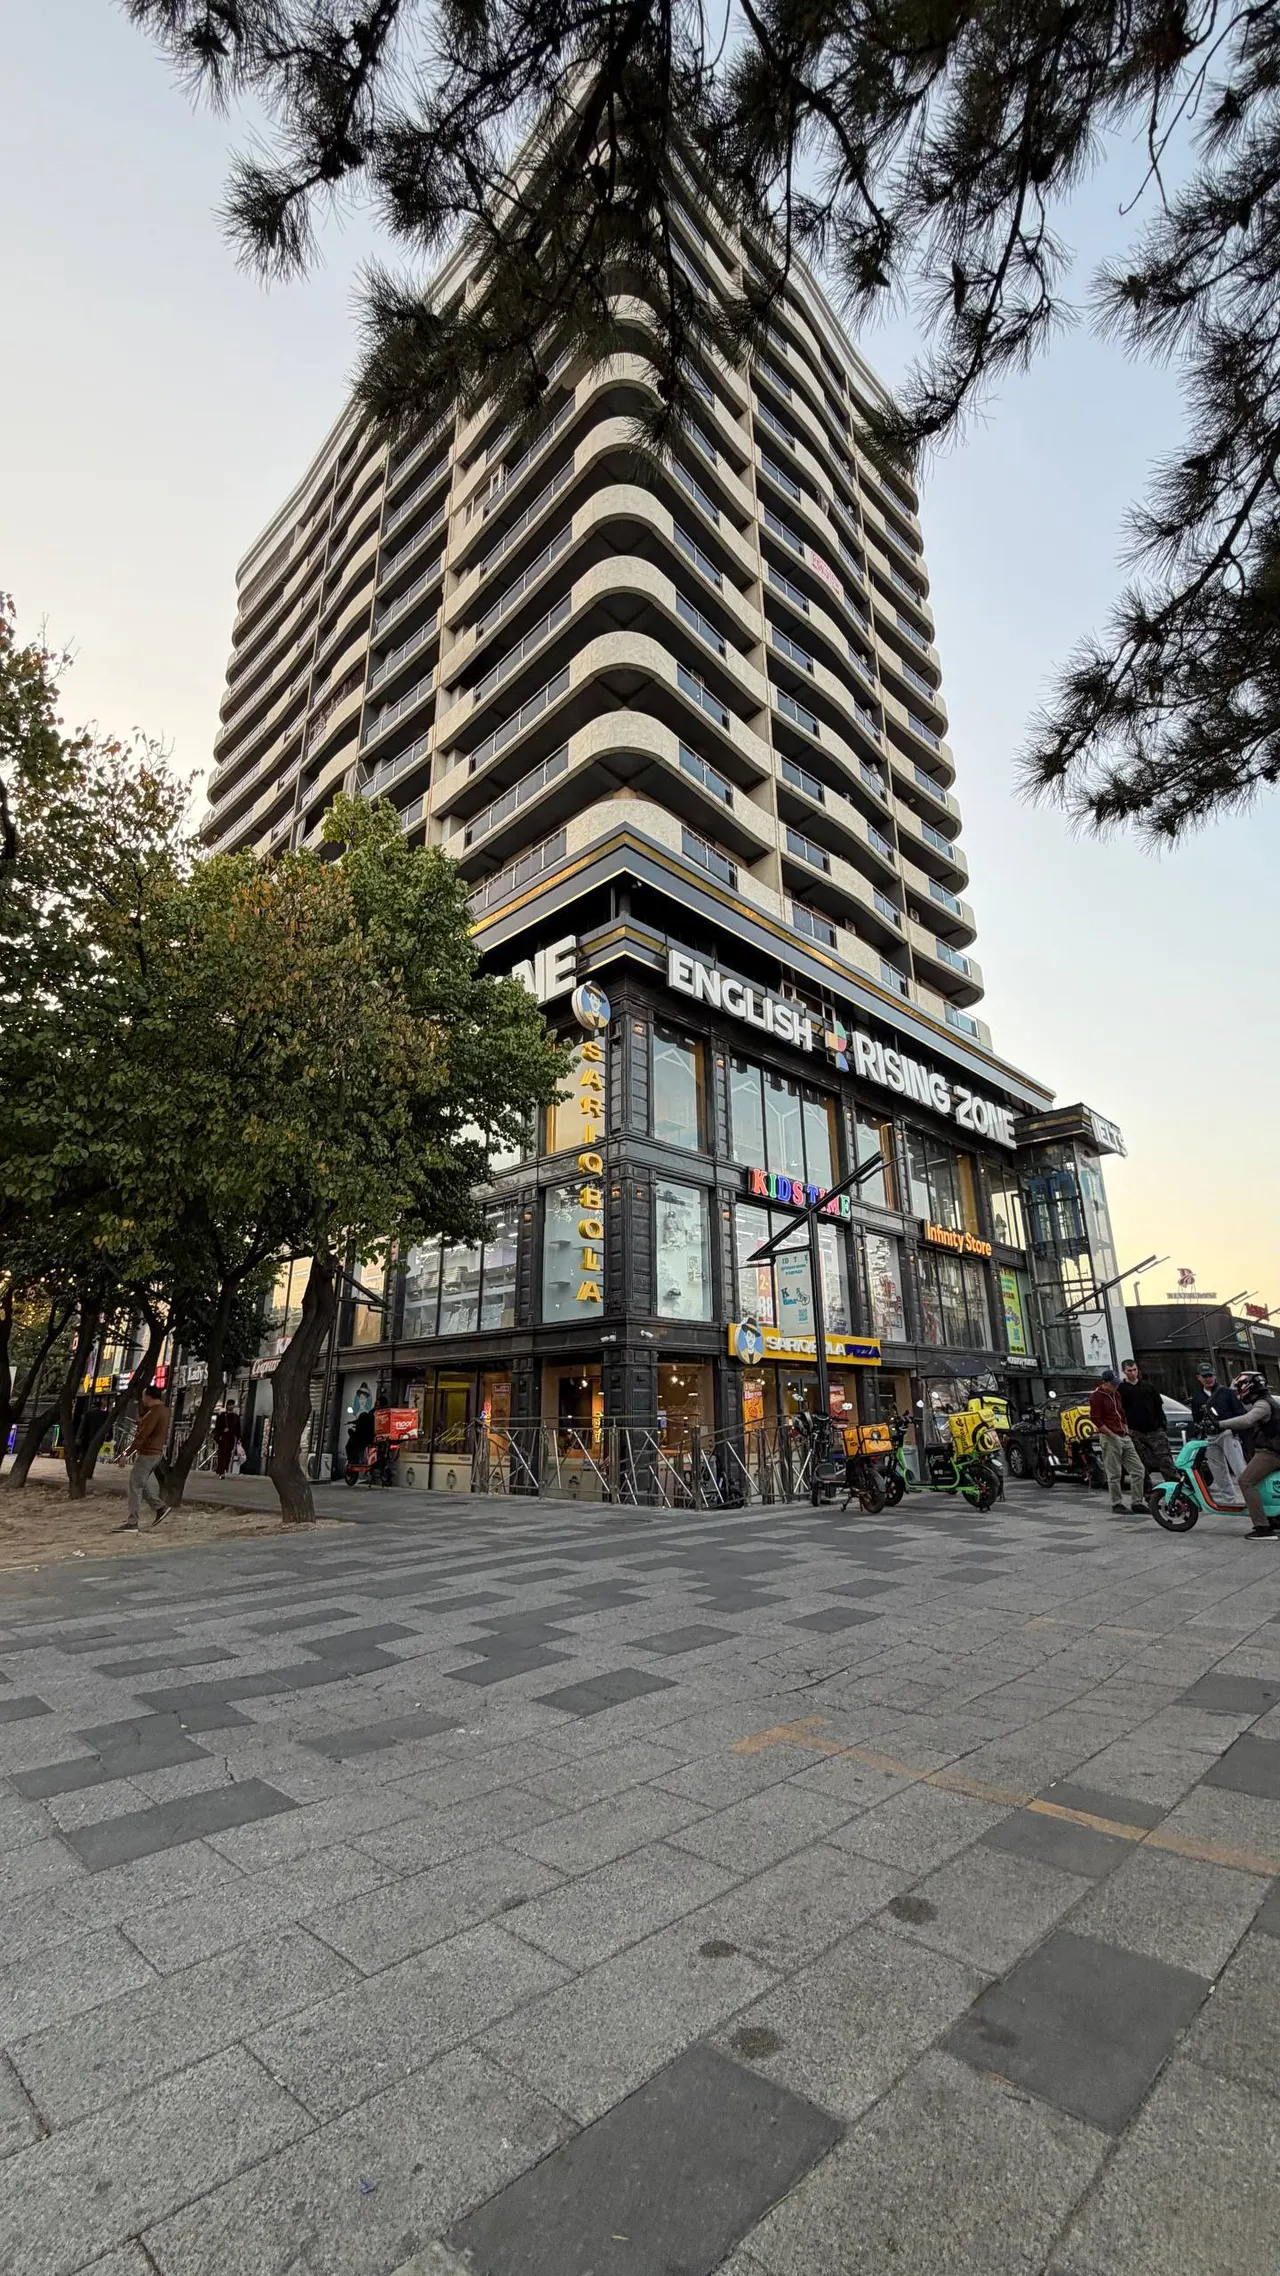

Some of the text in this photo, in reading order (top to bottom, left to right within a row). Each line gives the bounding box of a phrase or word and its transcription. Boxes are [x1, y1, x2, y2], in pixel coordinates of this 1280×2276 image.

[495, 935, 577, 1005] NE
[668, 949, 1018, 1150] ENGLISH RISING ZONE
[1091, 1113, 1128, 1158] IELTS
[750, 1168, 804, 1205] KIDS
[926, 1220, 992, 1257] Infinity Store
